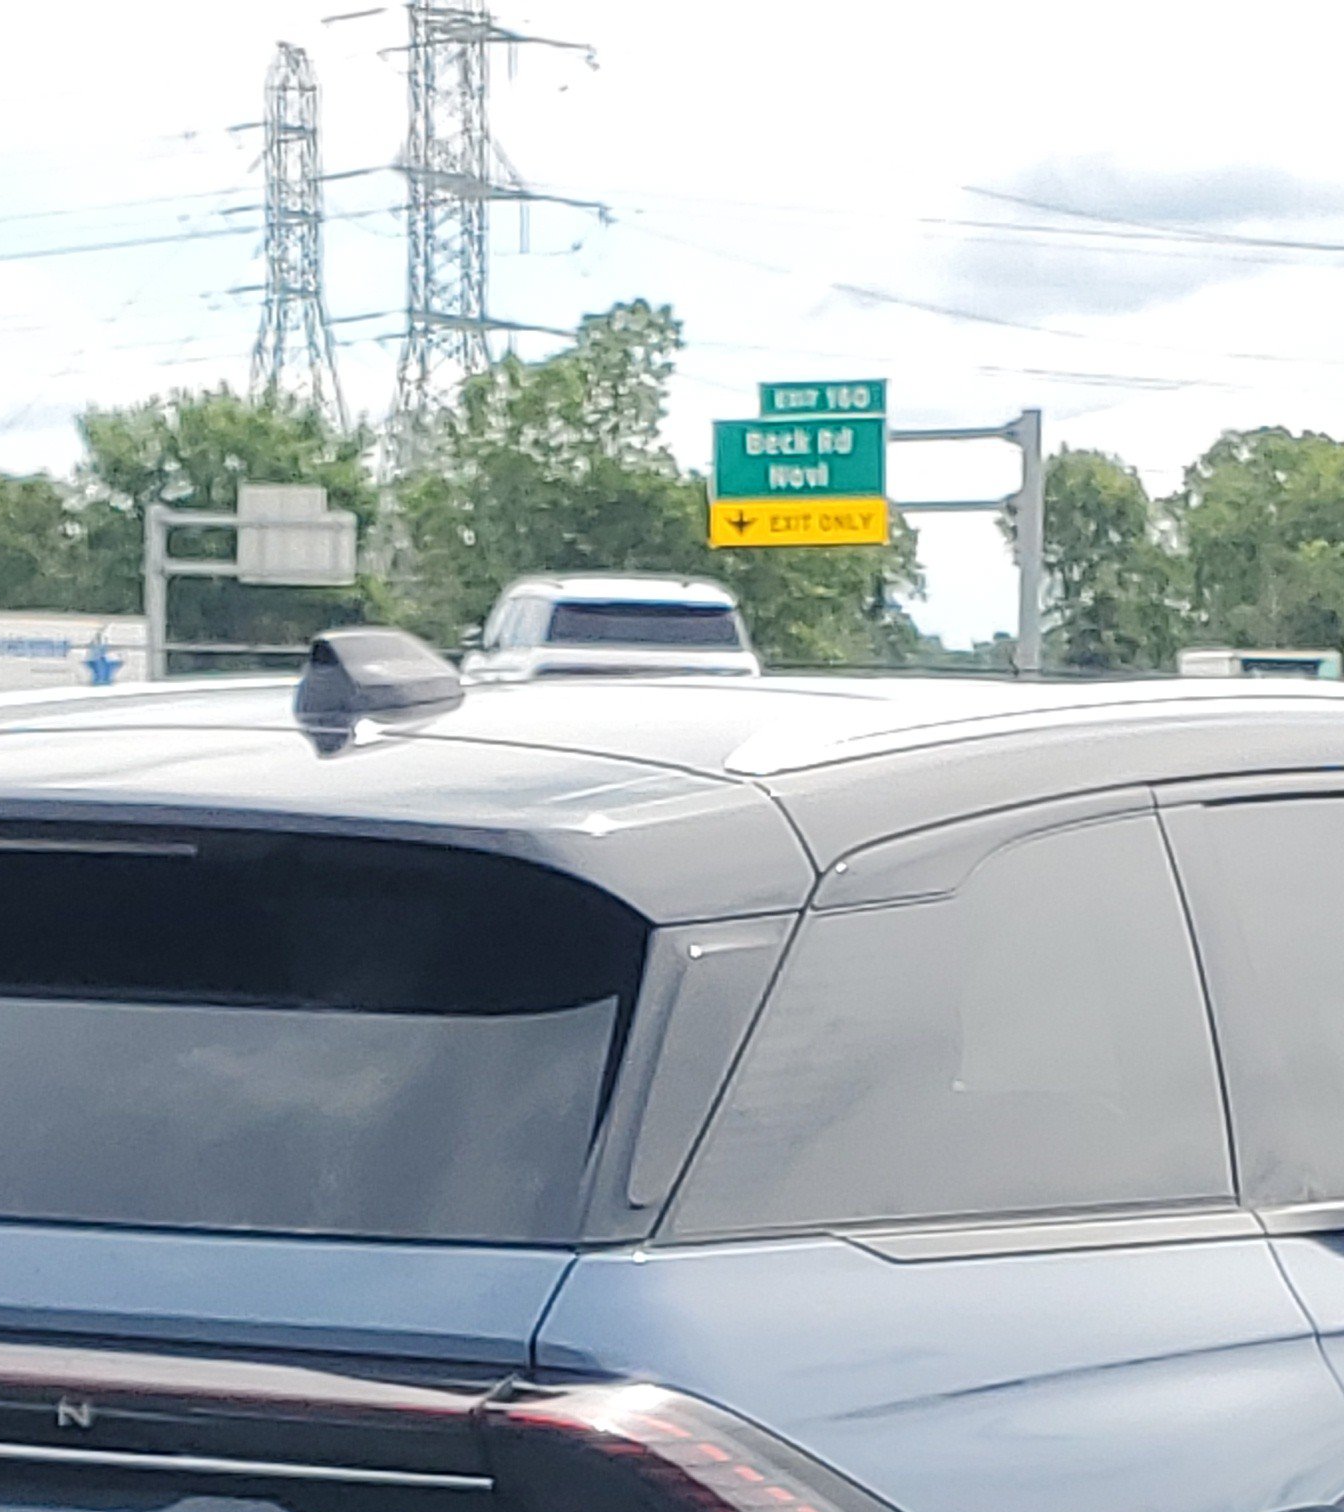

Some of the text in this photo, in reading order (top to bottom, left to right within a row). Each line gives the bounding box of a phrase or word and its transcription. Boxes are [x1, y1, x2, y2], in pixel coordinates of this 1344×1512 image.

[745, 425, 854, 455] Beck Rd
[768, 461, 829, 490] Novi
[769, 512, 875, 533] EXIT ONLY
